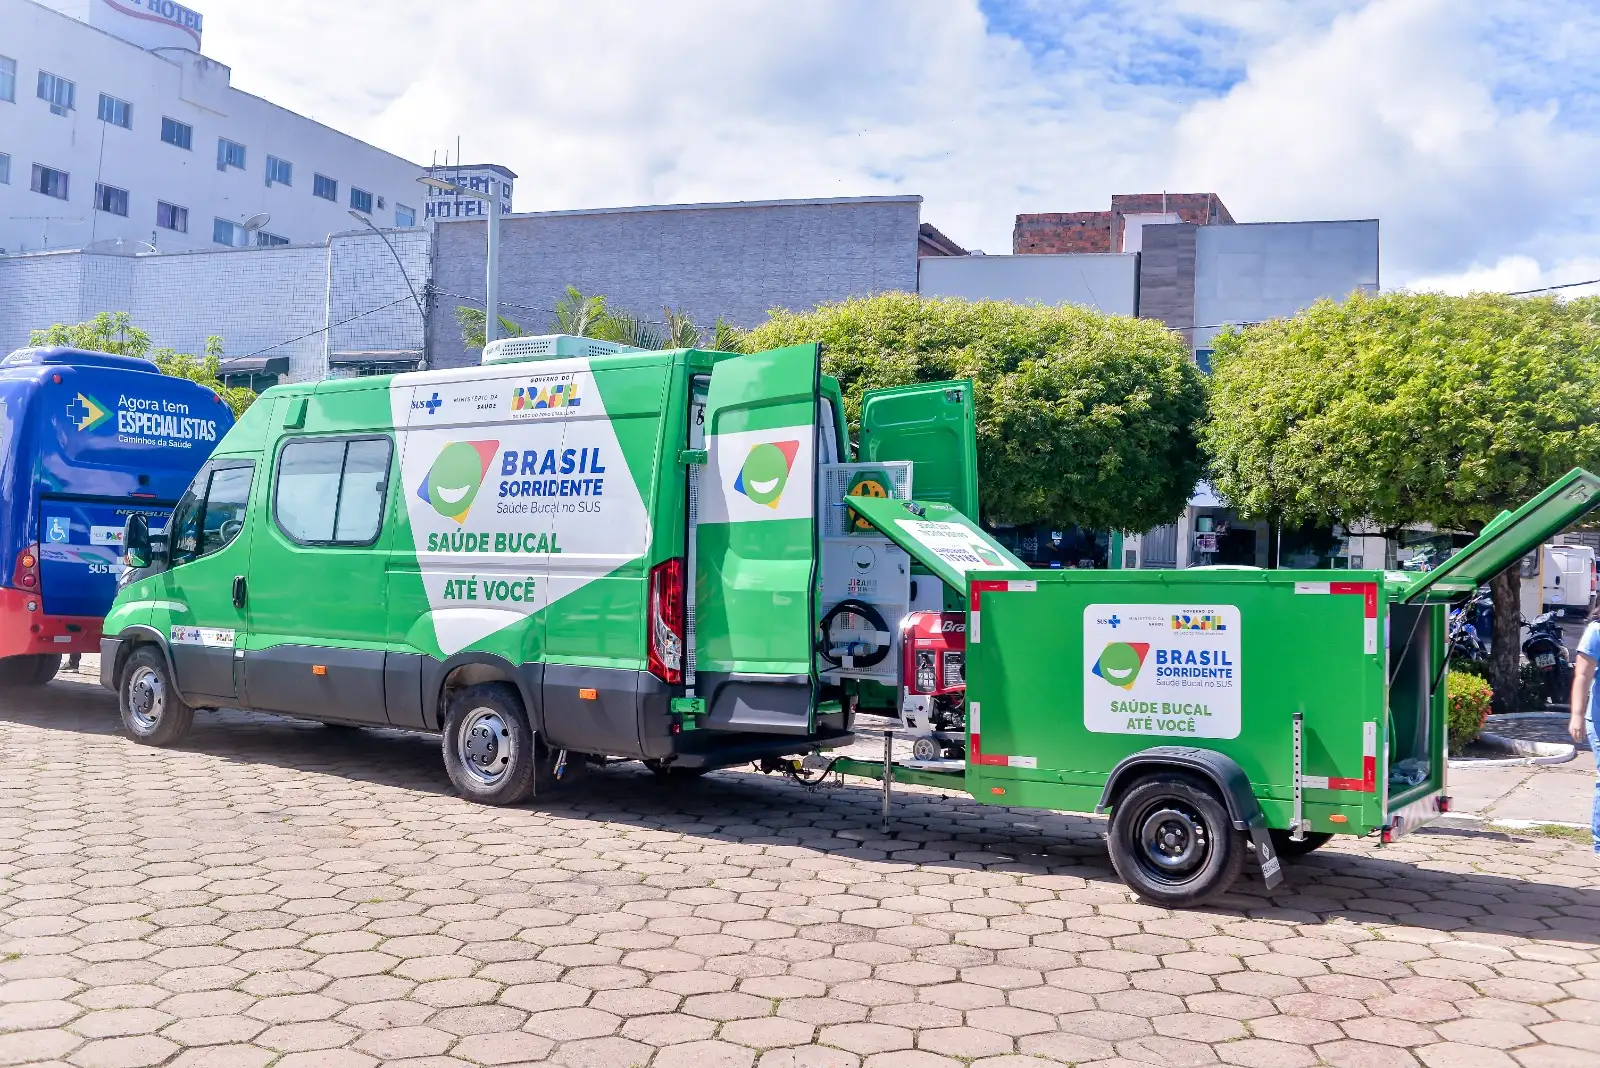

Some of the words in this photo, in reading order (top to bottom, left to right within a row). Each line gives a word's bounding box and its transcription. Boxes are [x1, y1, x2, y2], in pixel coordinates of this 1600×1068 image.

[148, 0, 202, 32] HOTEL
[425, 201, 486, 217] HOTEL
[530, 375, 559, 383] GOVERNO
[118, 395, 159, 411] Agora
[162, 399, 189, 414] tem
[411, 401, 425, 409] SUS
[511, 384, 581, 411] BRASIL
[118, 410, 216, 441] ESPECIALISTAS
[118, 434, 155, 445] Caminhos
[157, 438, 167, 446] da
[169, 438, 192, 449] Saúde
[501, 447, 606, 476] BRASIL
[499, 478, 603, 497] SORRIDENTE
[497, 501, 528, 514] Saúde
[530, 502, 559, 514] Bucal
[562, 504, 575, 513] no
[578, 501, 601, 513] SUS
[427, 528, 489, 552] SAÚDE
[494, 532, 562, 553] BUCAL
[89, 563, 108, 574] SUS
[443, 574, 477, 600] ATÉ
[483, 576, 536, 602] VOCÊ
[1171, 615, 1226, 630] BRASIL
[1156, 650, 1232, 665] BRASIL
[1156, 667, 1232, 678] SORRIDENTE
[1182, 679, 1203, 688] Bucal
[1110, 699, 1157, 714] SAÚDE
[1162, 703, 1212, 716] BUCAL
[1127, 716, 1152, 731] ATÉ
[1157, 717, 1196, 732] VOCÊ
